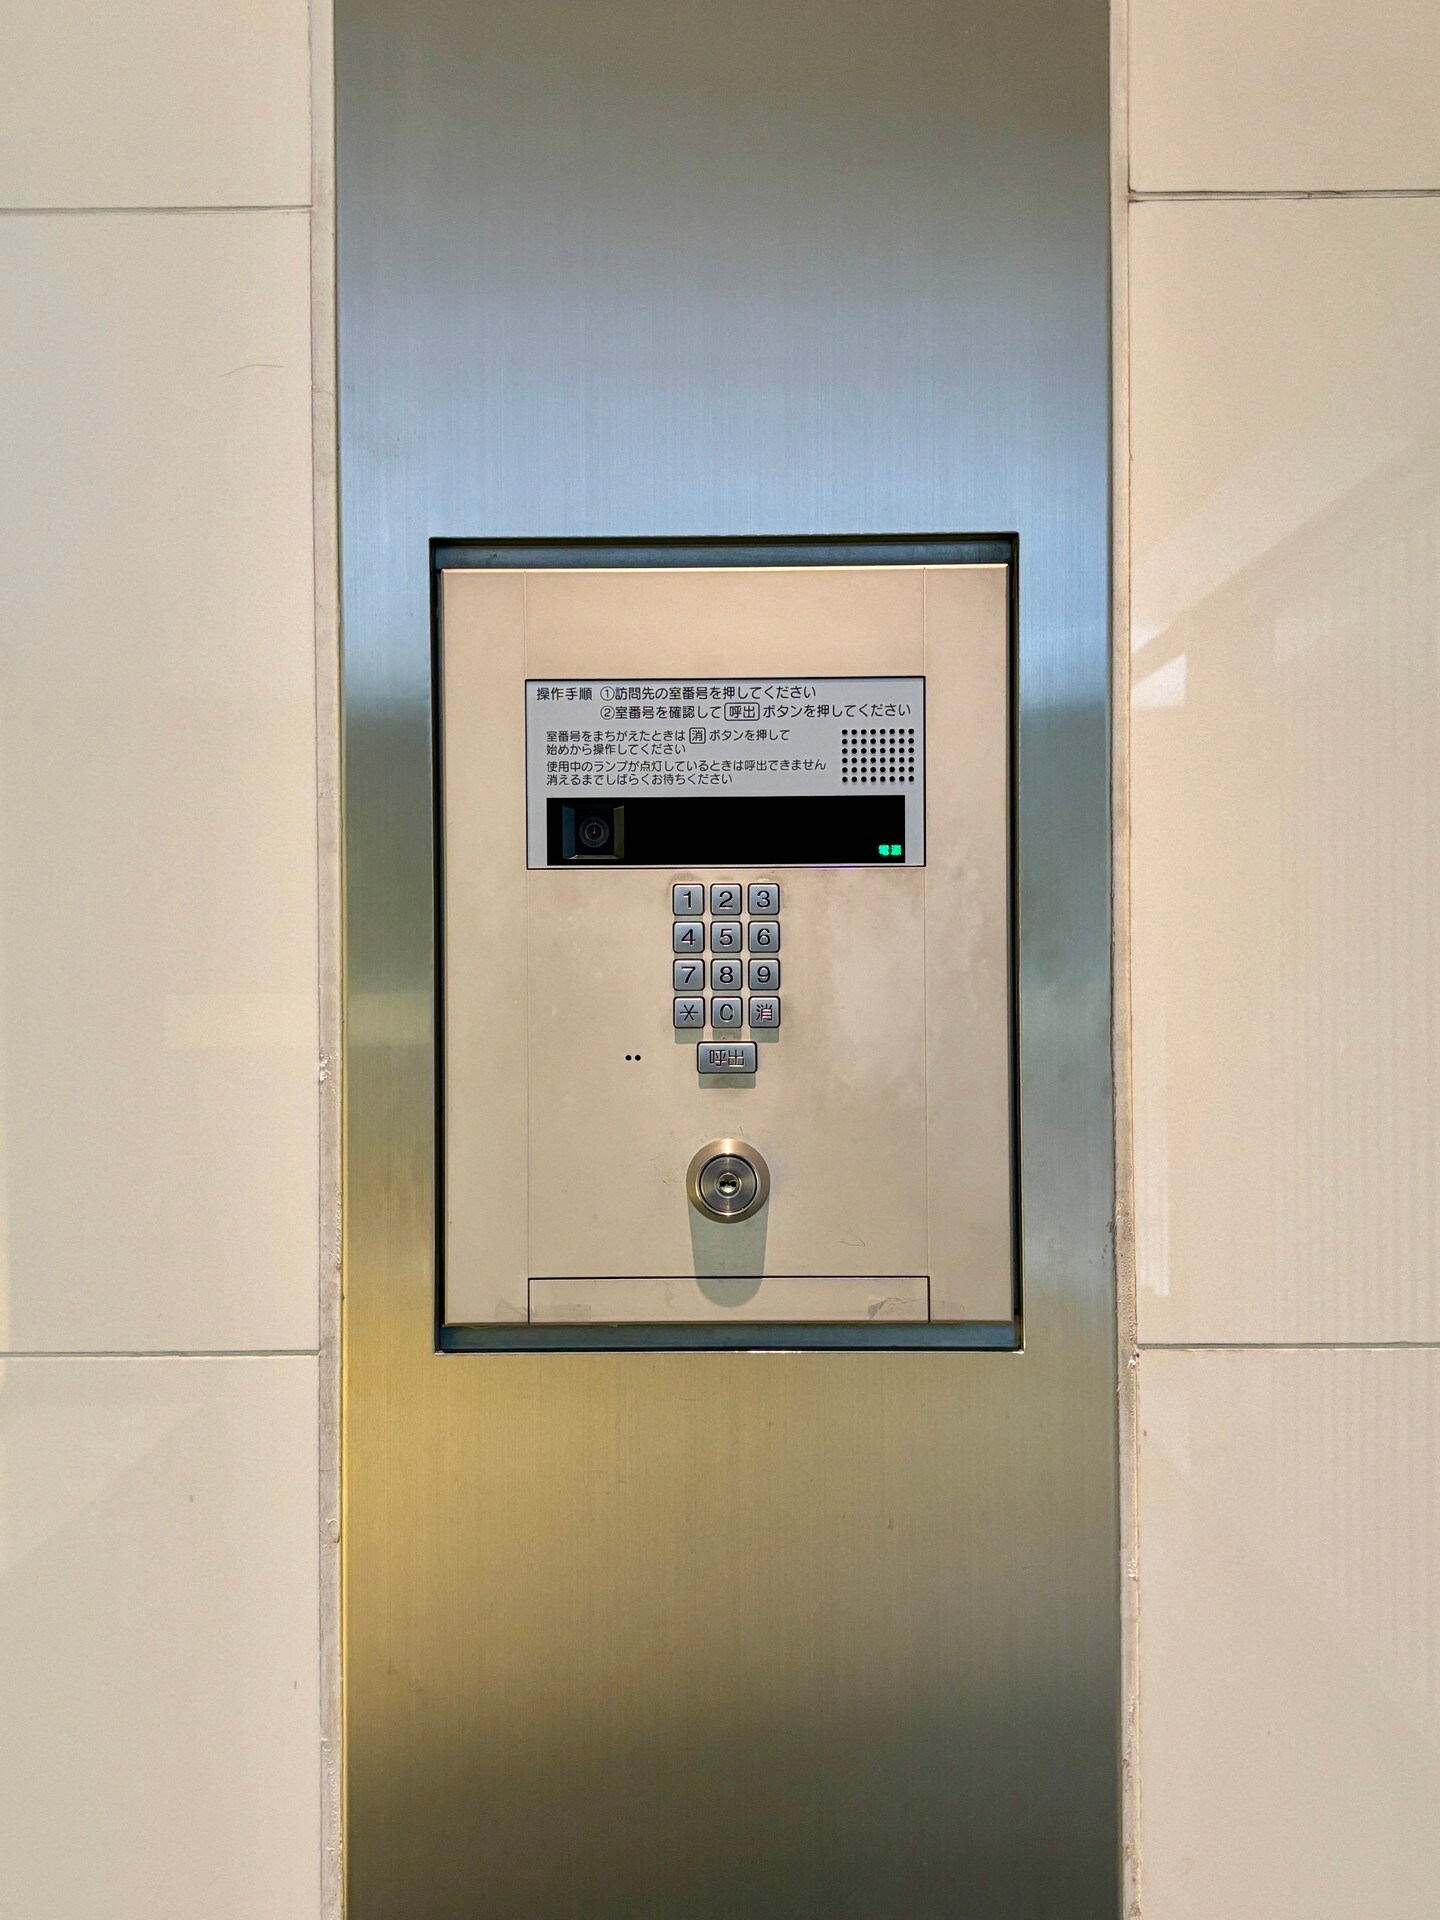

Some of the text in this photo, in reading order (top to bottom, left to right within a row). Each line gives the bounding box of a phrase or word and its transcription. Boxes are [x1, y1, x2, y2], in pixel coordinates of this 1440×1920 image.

[536, 686, 816, 701] 操作手順 ①訪問先の室番号を押してください
[546, 743, 686, 756] 始めから操作してください
[546, 759, 827, 773] 使用中のランプが点灯しているときは呼出できません
[546, 773, 733, 786] 消えるまでしばらくお待ちください
[683, 891, 771, 909] 1 2 3
[681, 928, 771, 946] 4 5 6
[681, 966, 771, 984] 7 8 9
[755, 1003, 773, 1022] 消
[709, 1049, 745, 1067] 呼出
